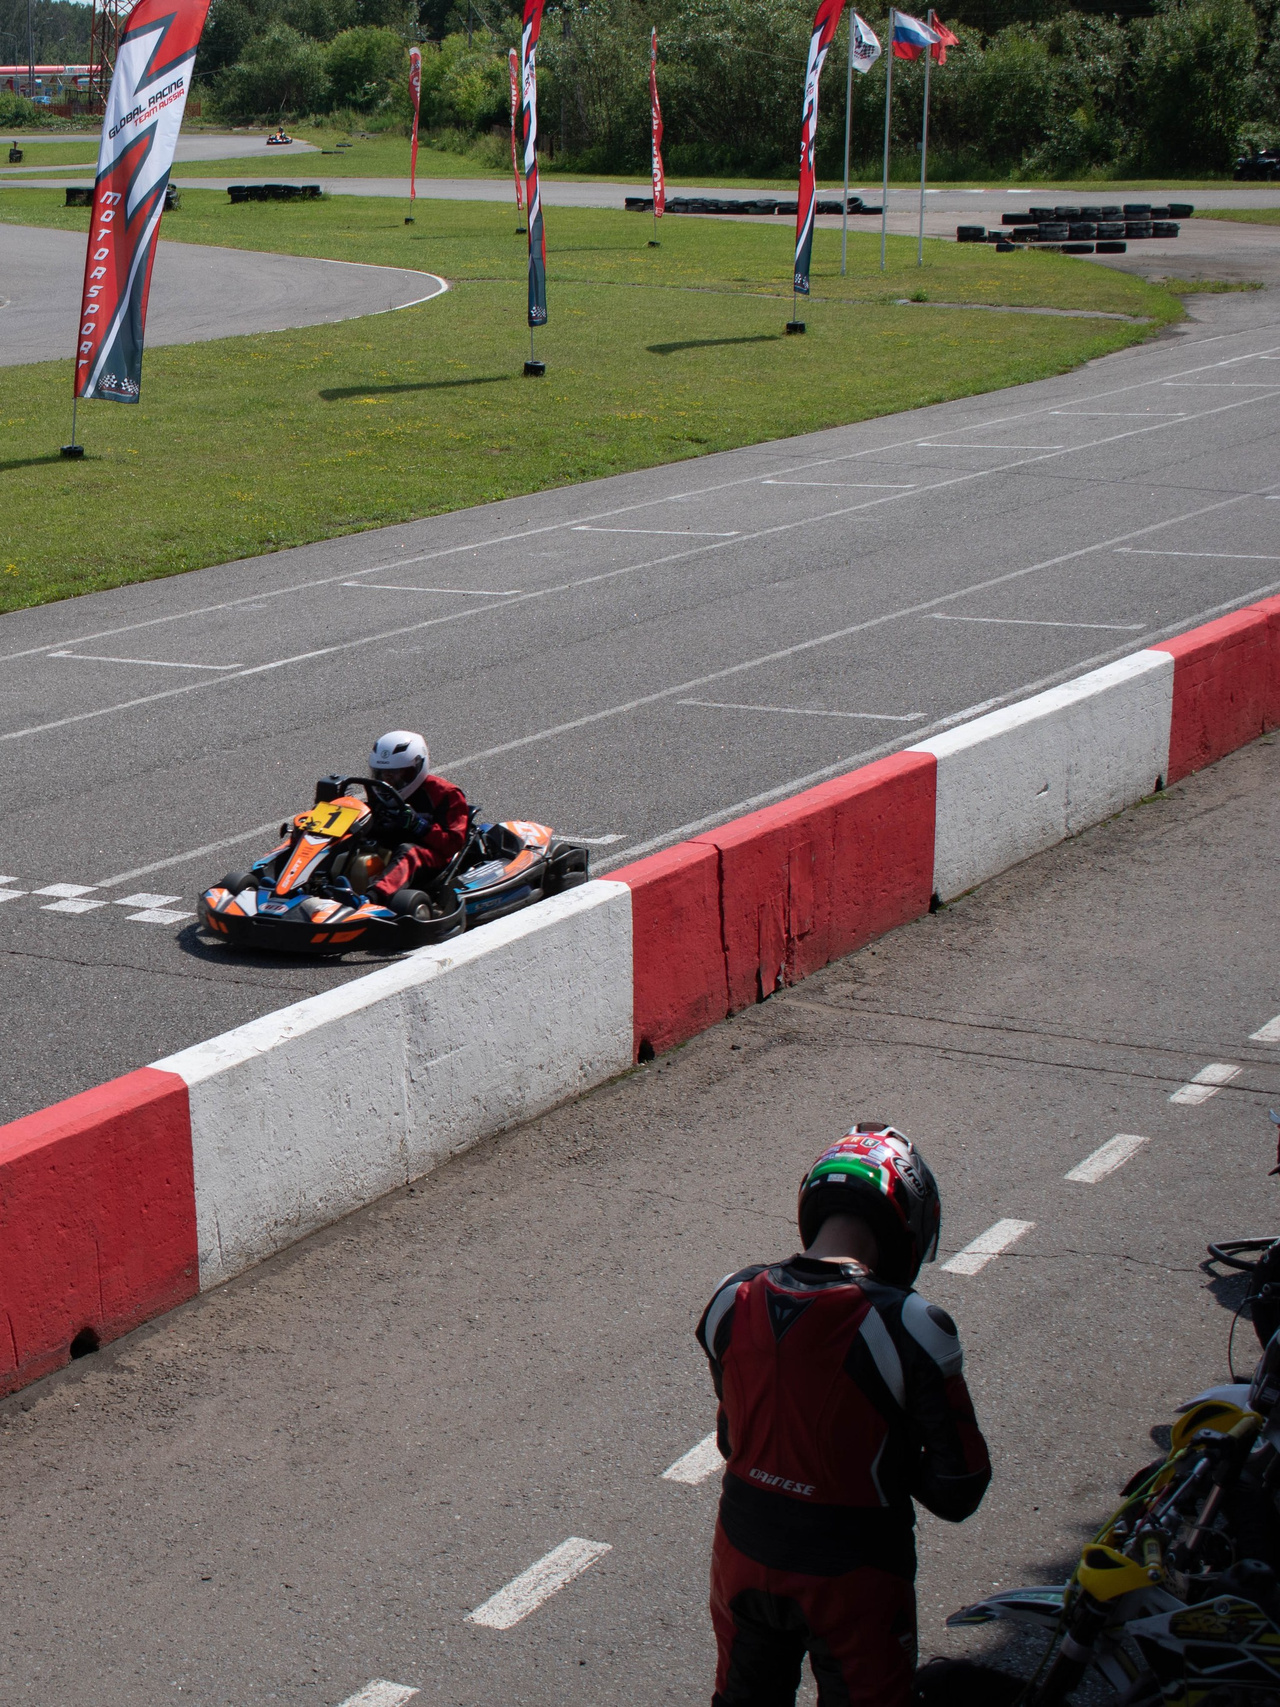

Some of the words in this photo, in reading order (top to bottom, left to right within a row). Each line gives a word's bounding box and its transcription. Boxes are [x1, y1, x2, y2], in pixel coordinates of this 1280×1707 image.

[108, 105, 147, 139] GLOBAL
[148, 77, 184, 108] RACING
[134, 106, 158, 127] TEAM
[158, 88, 185, 111] RUSSIA
[323, 811, 342, 829] 1
[748, 1467, 816, 1496] DAINESE
